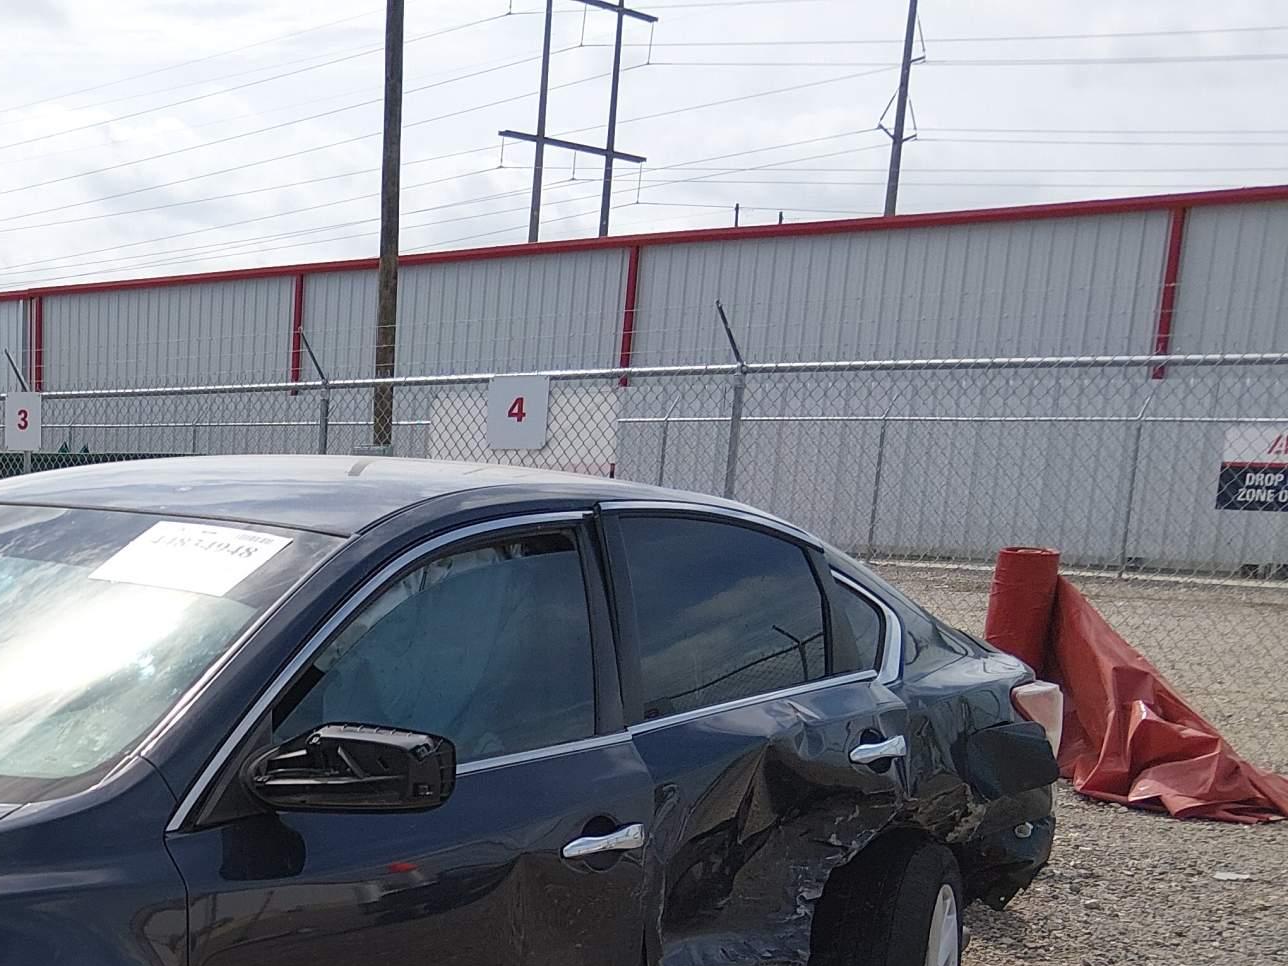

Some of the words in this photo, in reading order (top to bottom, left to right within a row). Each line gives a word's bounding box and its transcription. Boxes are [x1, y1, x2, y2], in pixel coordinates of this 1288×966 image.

[507, 396, 526, 422] 4
[17, 409, 29, 430] 3
[1245, 472, 1285, 487] DROP
[1236, 488, 1275, 502] ZONE
